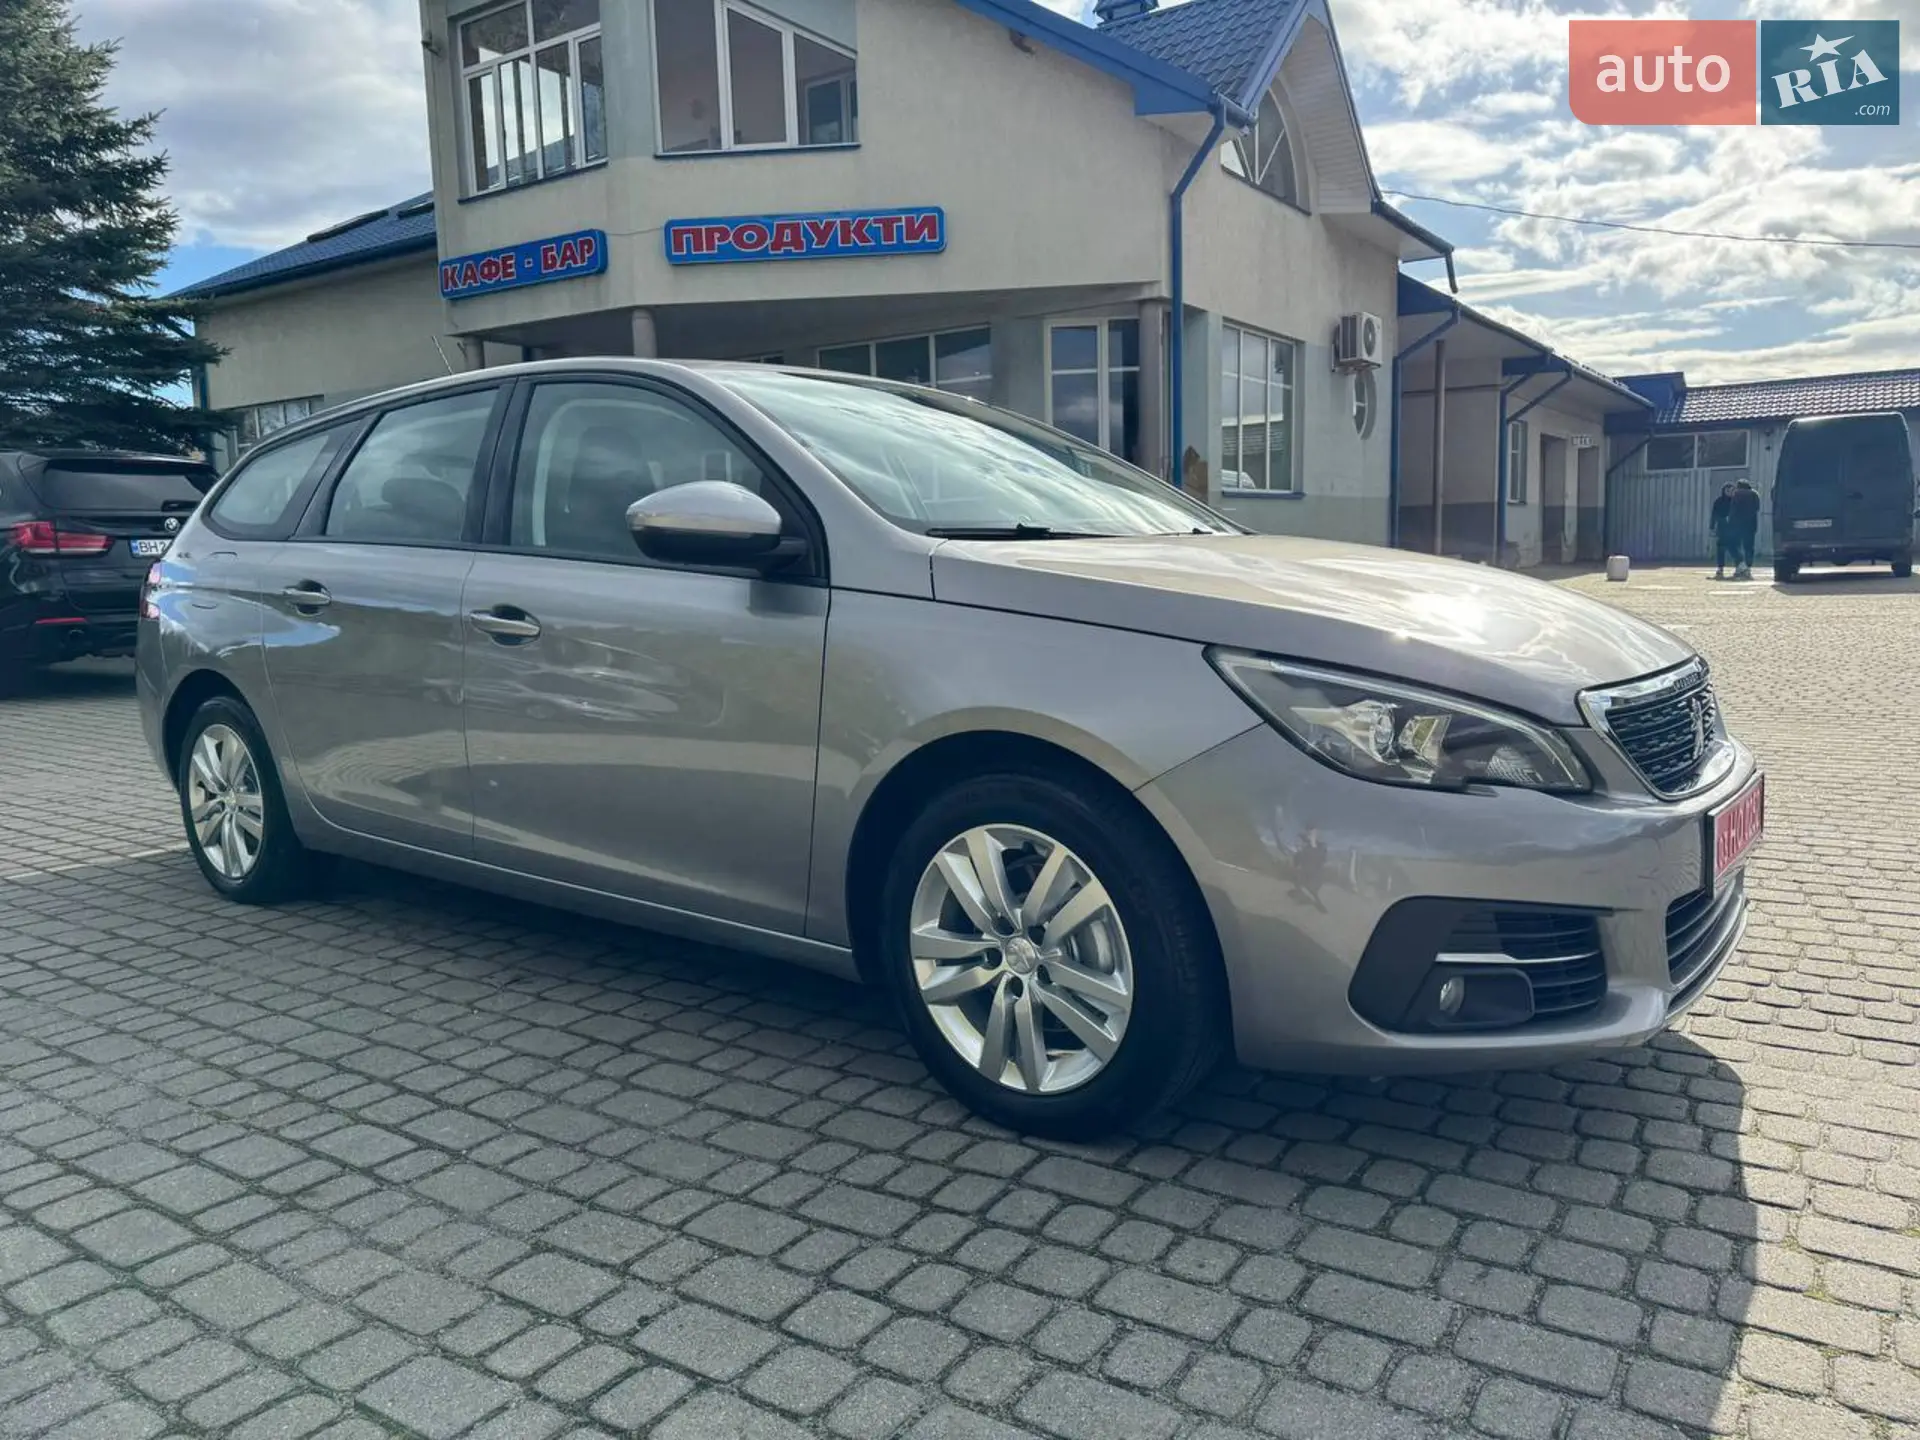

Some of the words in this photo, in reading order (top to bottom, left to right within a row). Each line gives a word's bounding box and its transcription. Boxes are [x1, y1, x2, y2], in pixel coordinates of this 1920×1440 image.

[670, 213, 939, 256] ПРОДУКТИ
[442, 253, 516, 291] КАФЕ
[540, 236, 595, 273] БАР
